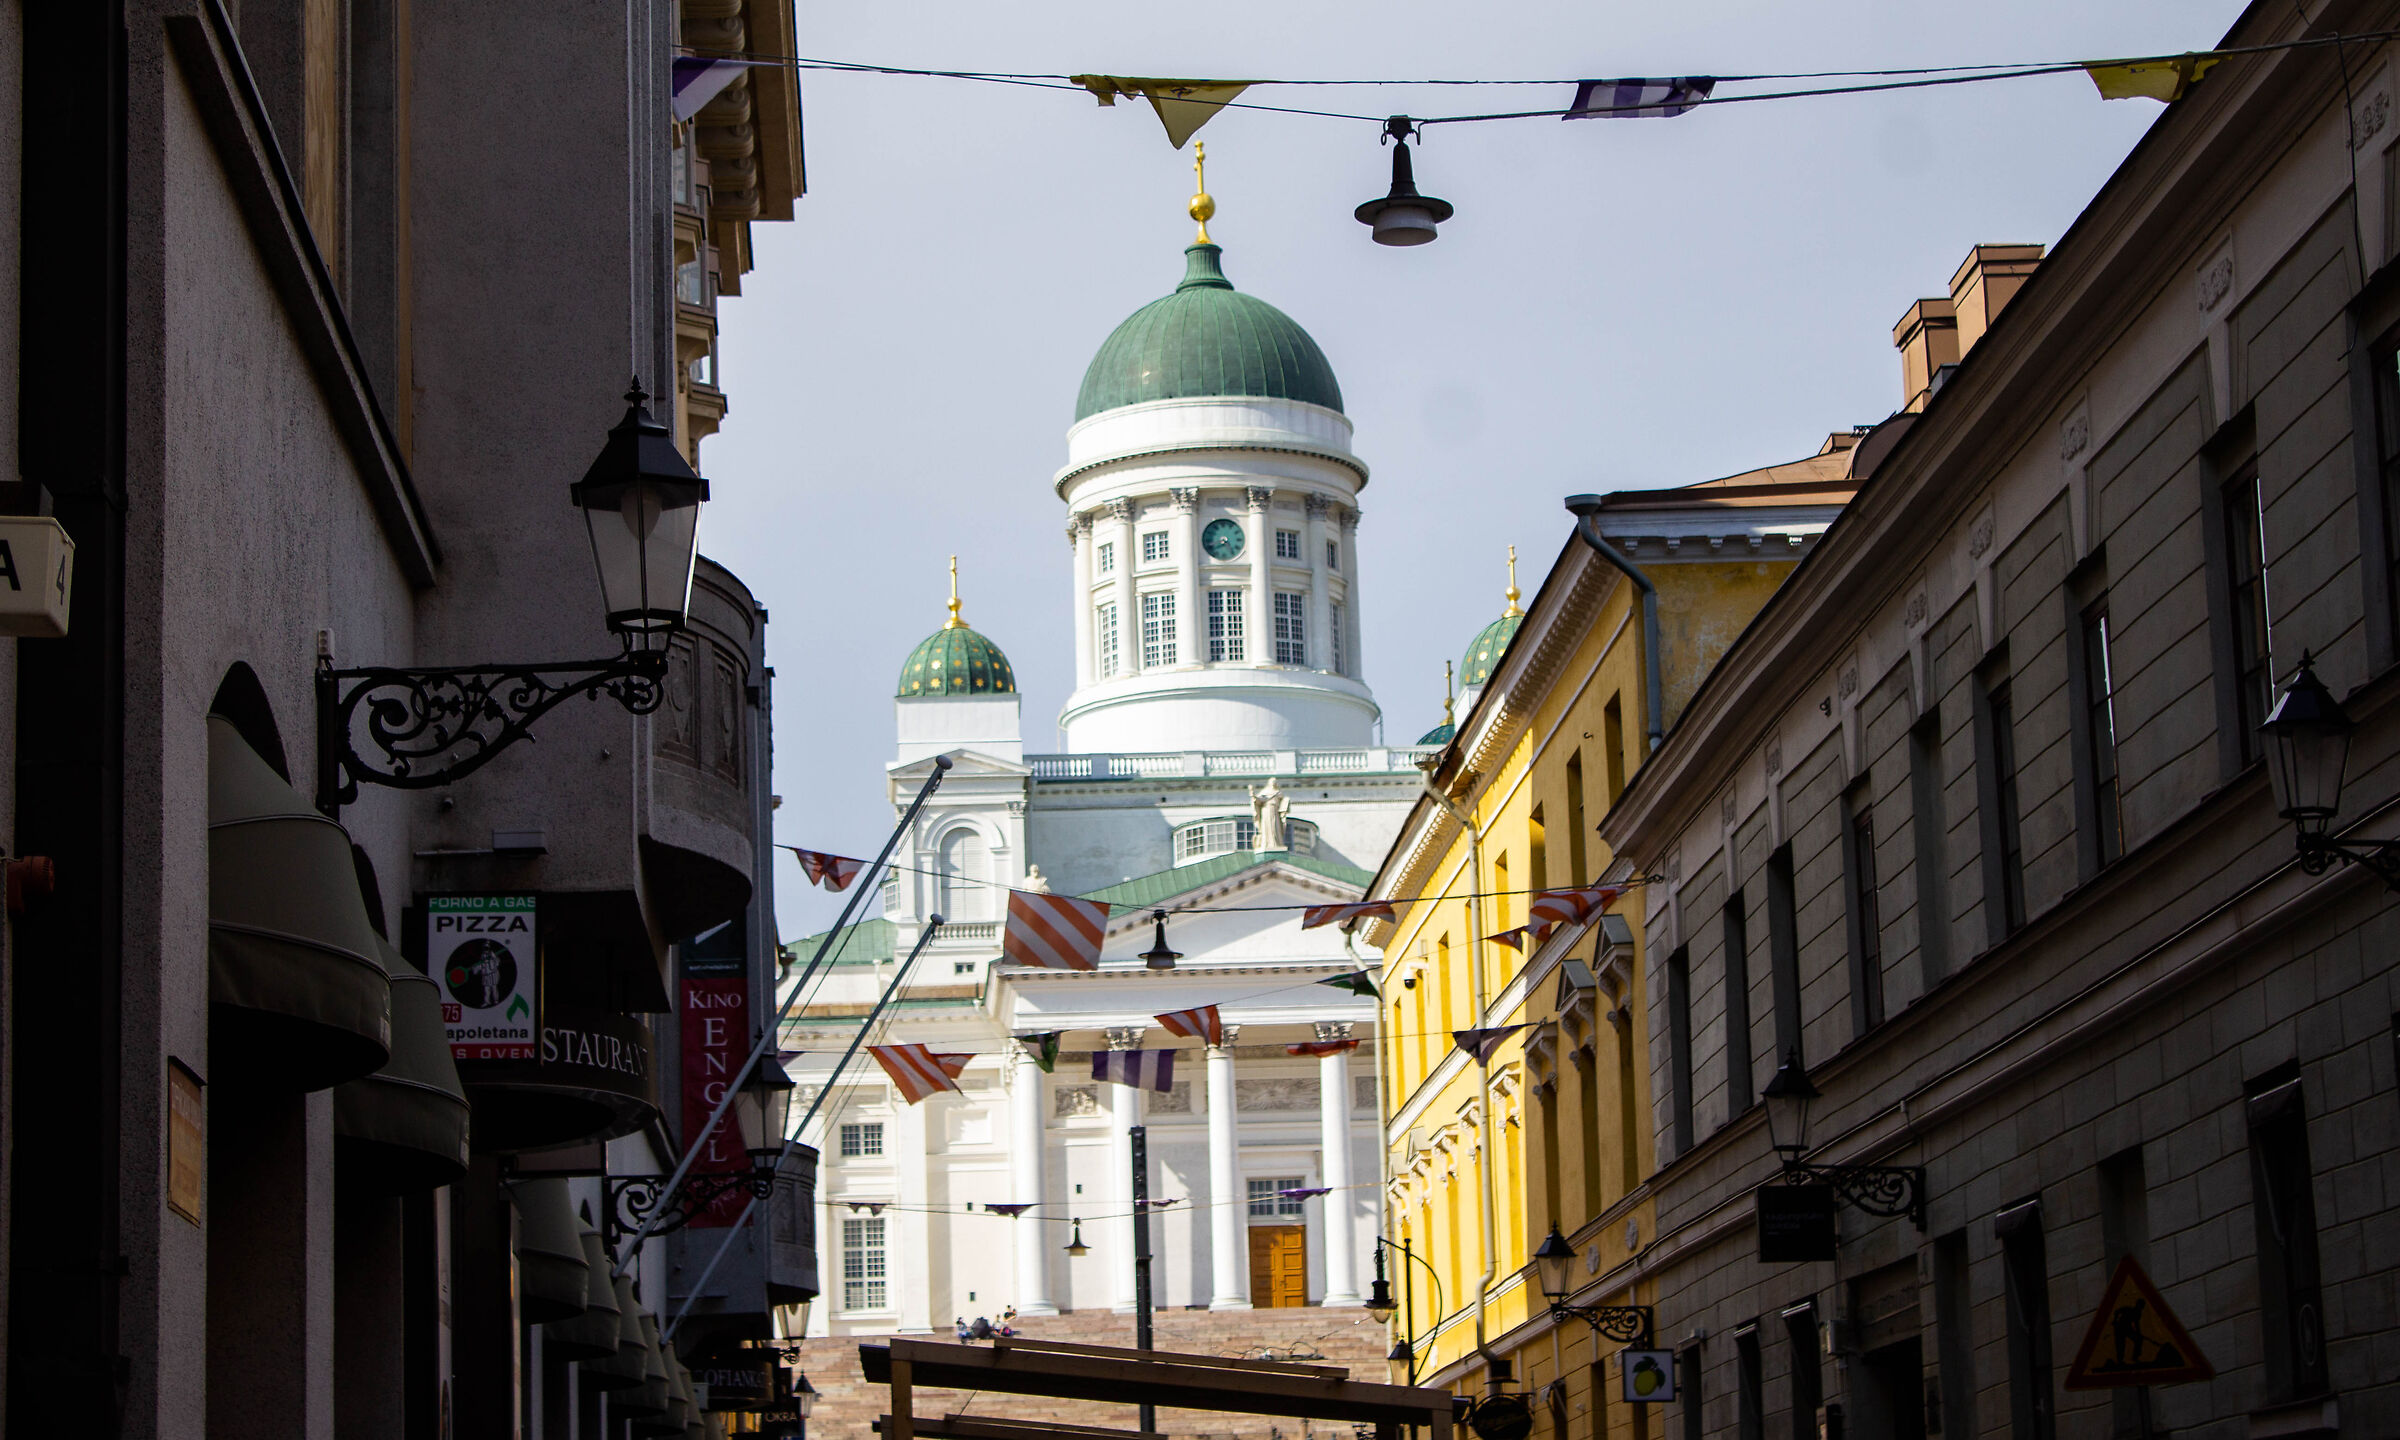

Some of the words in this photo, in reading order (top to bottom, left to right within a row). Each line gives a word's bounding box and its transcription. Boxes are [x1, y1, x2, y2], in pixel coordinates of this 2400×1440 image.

[56, 554, 65, 605] 4
[429, 897, 484, 908] FORNO
[489, 897, 500, 908] A
[504, 897, 536, 908] GAS
[437, 916, 528, 932] PIZZA
[441, 1005, 459, 1021] 75
[446, 1027, 528, 1041] apoletana
[480, 1048, 535, 1059] OVEN
